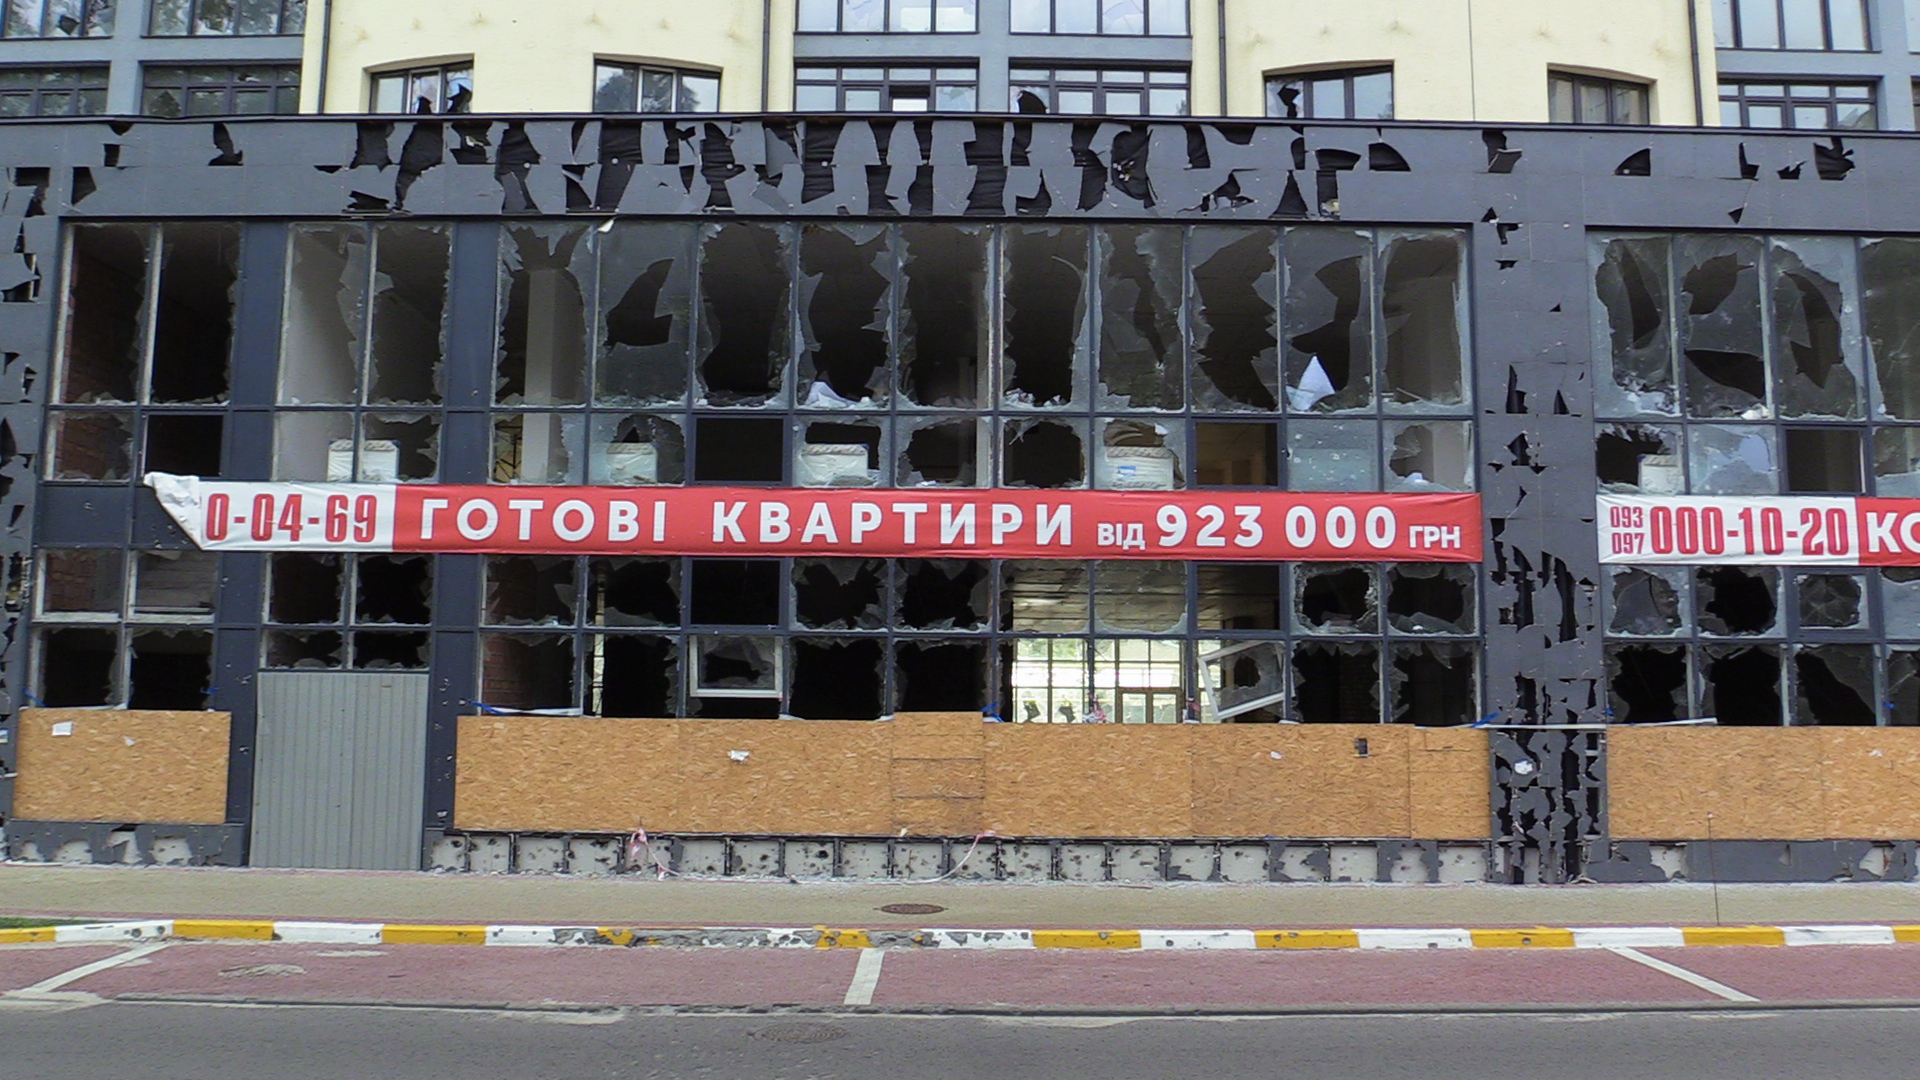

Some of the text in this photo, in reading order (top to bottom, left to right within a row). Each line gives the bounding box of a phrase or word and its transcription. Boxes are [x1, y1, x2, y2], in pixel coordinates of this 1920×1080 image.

[420, 498, 1461, 550] ГОТОВІ КВАРТИРИ ВІД 923 000 ГРН
[1610, 506, 1643, 528] 093
[1650, 506, 1849, 556] 000-10-20
[1611, 532, 1645, 554] 097
